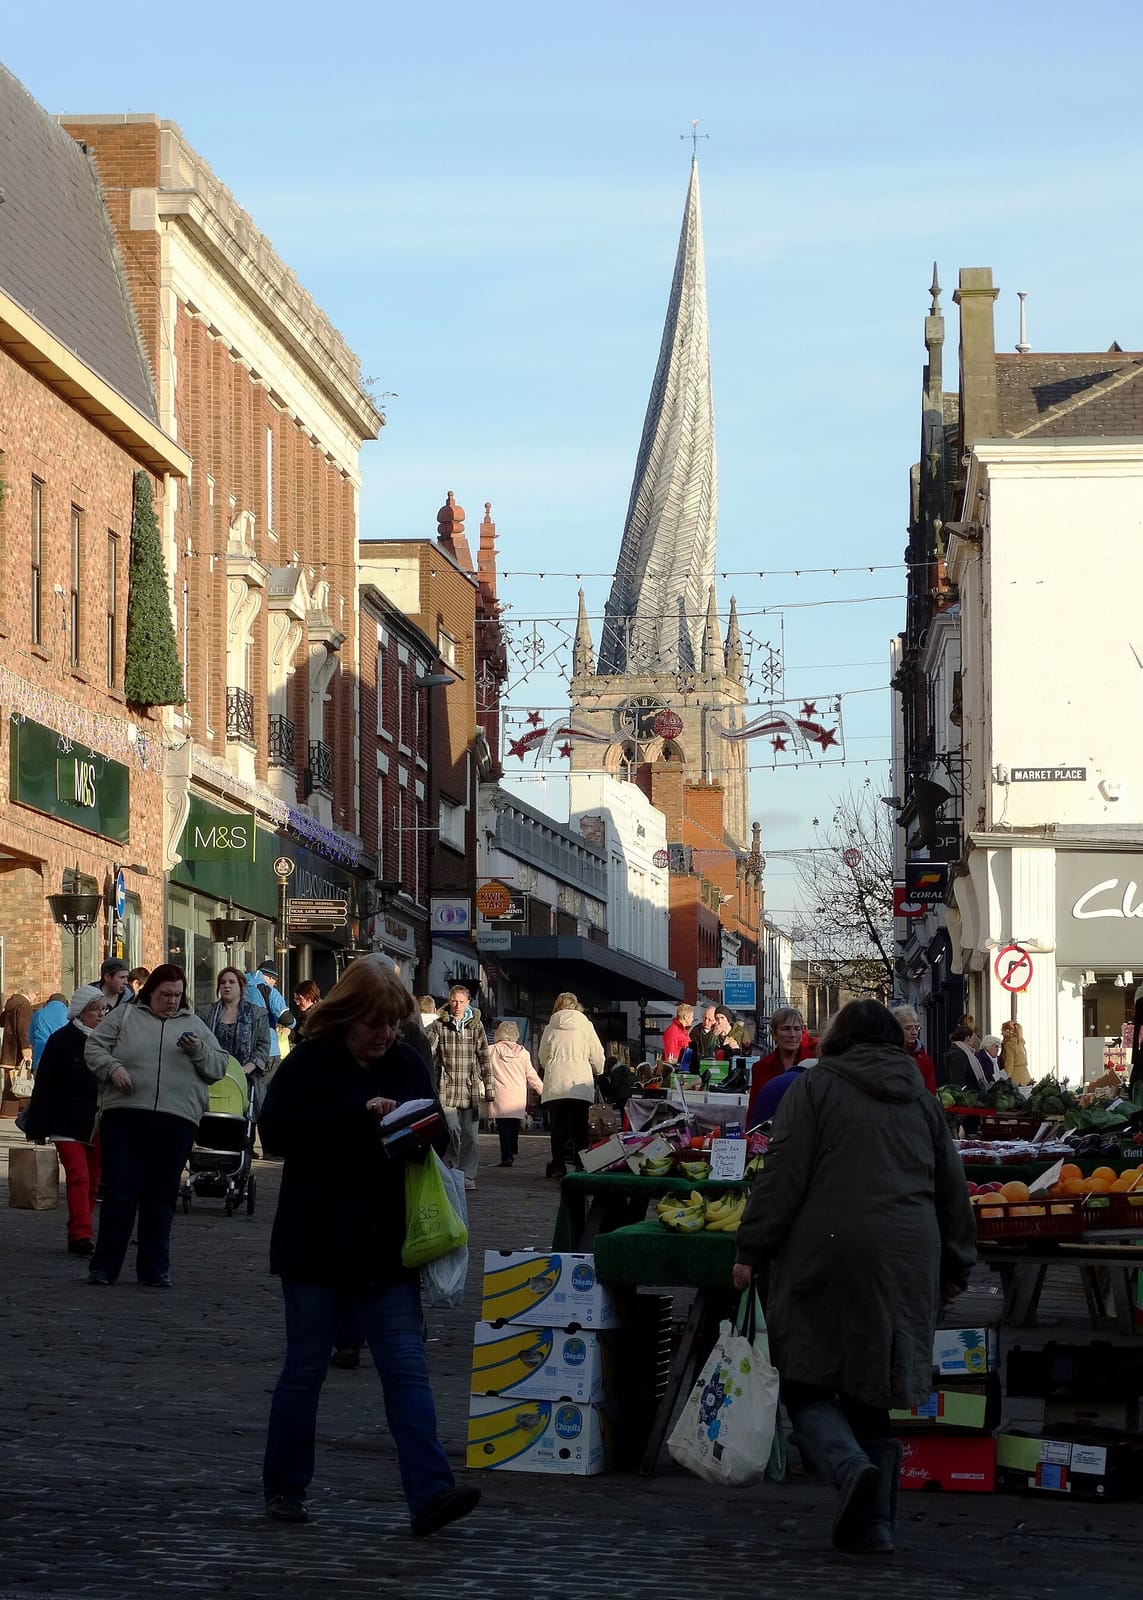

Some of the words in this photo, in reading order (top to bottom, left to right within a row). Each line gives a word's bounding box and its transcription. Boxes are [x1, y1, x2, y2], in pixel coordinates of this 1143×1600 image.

[1014, 770, 1052, 780] MARKET
[1054, 769, 1083, 779] PLACE
[75, 758, 95, 807] M&S
[195, 826, 247, 849] M&S
[480, 892, 505, 901] KWIK
[910, 891, 943, 899] CORAL
[1072, 878, 1143, 919] Cl
[484, 901, 502, 909] TAN
[556, 1422, 581, 1434] Chiquita
